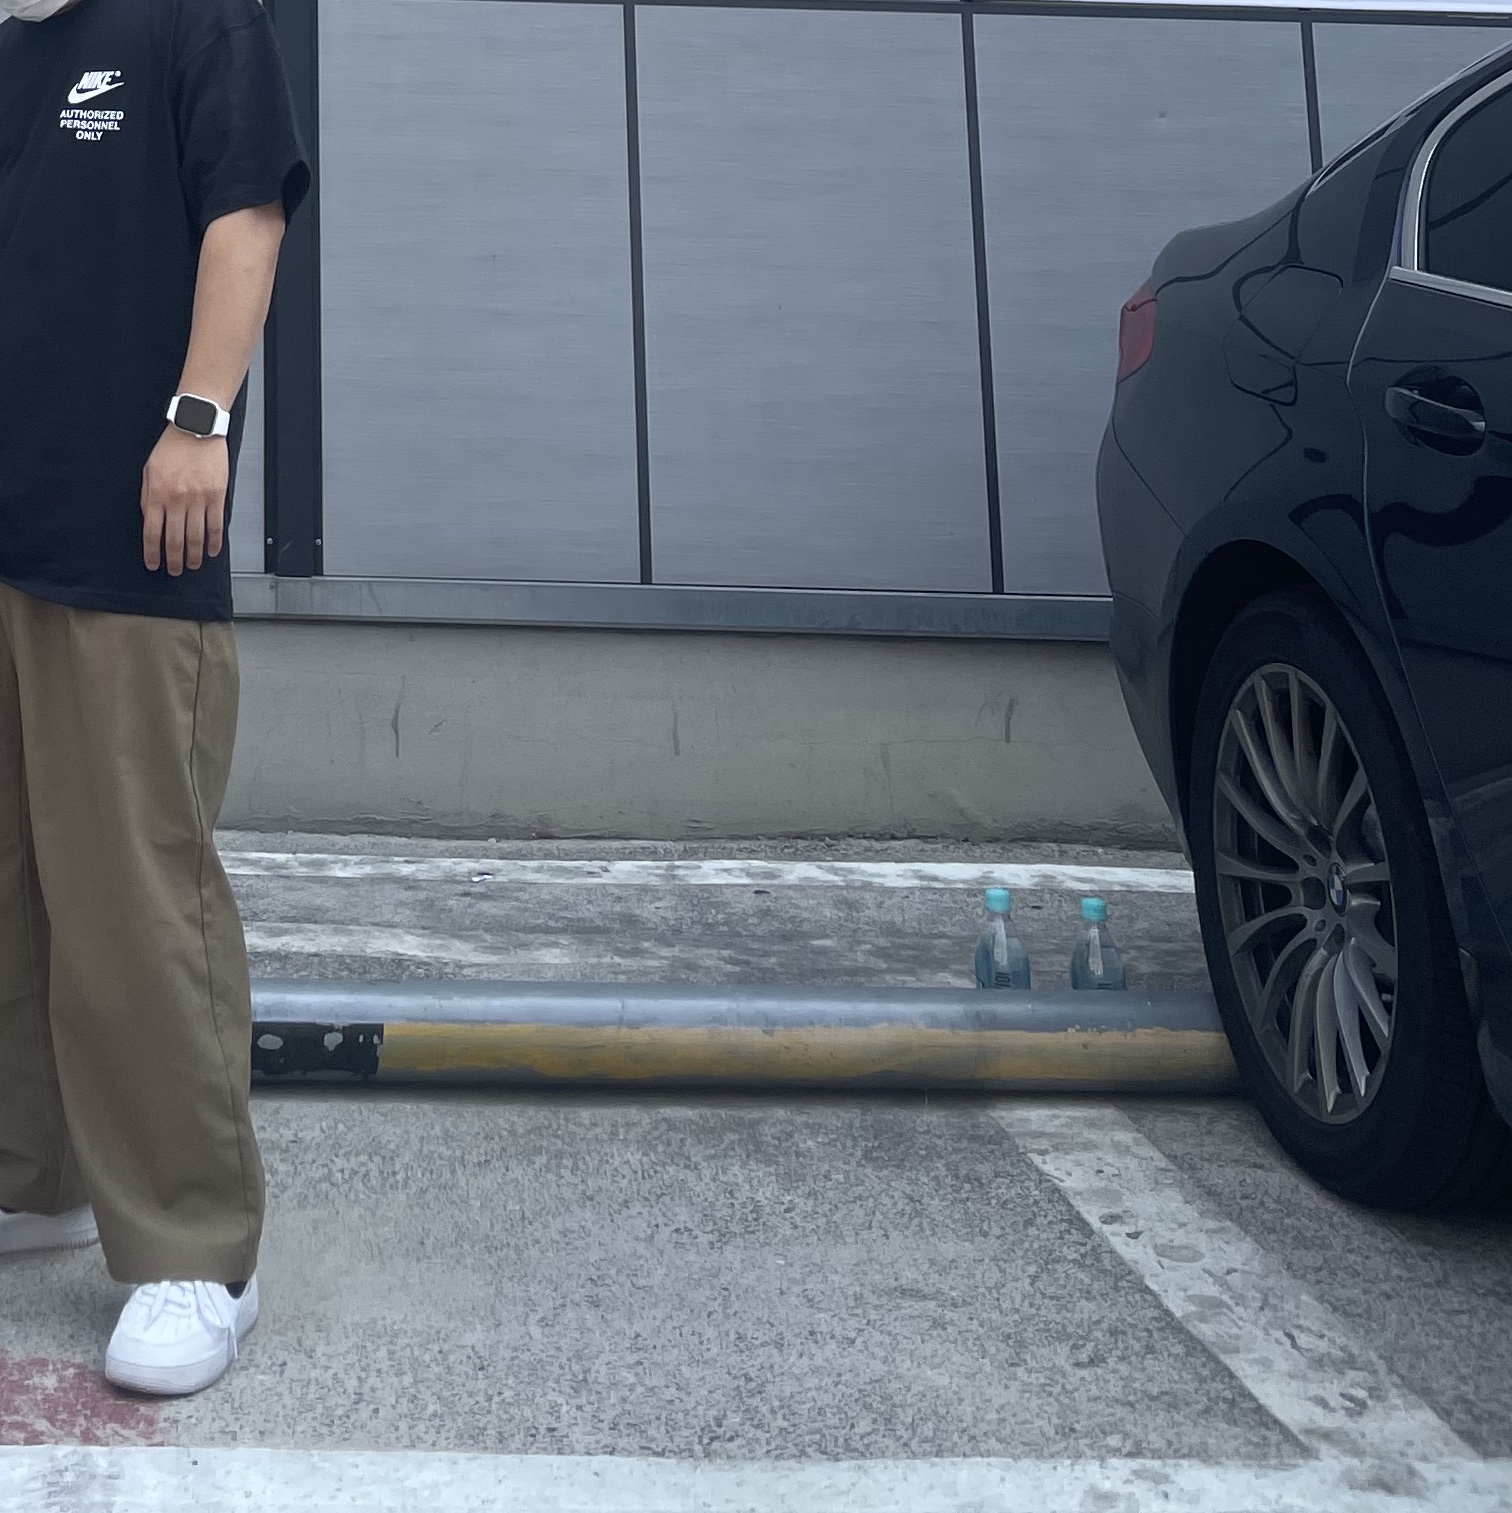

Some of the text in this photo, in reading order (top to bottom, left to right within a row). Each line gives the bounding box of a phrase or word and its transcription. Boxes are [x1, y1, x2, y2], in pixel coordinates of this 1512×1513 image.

[77, 71, 115, 89] NIKE
[59, 109, 125, 120] AUTHORIZED
[59, 119, 121, 131] PERSONNEL
[75, 130, 104, 141] ONLY
